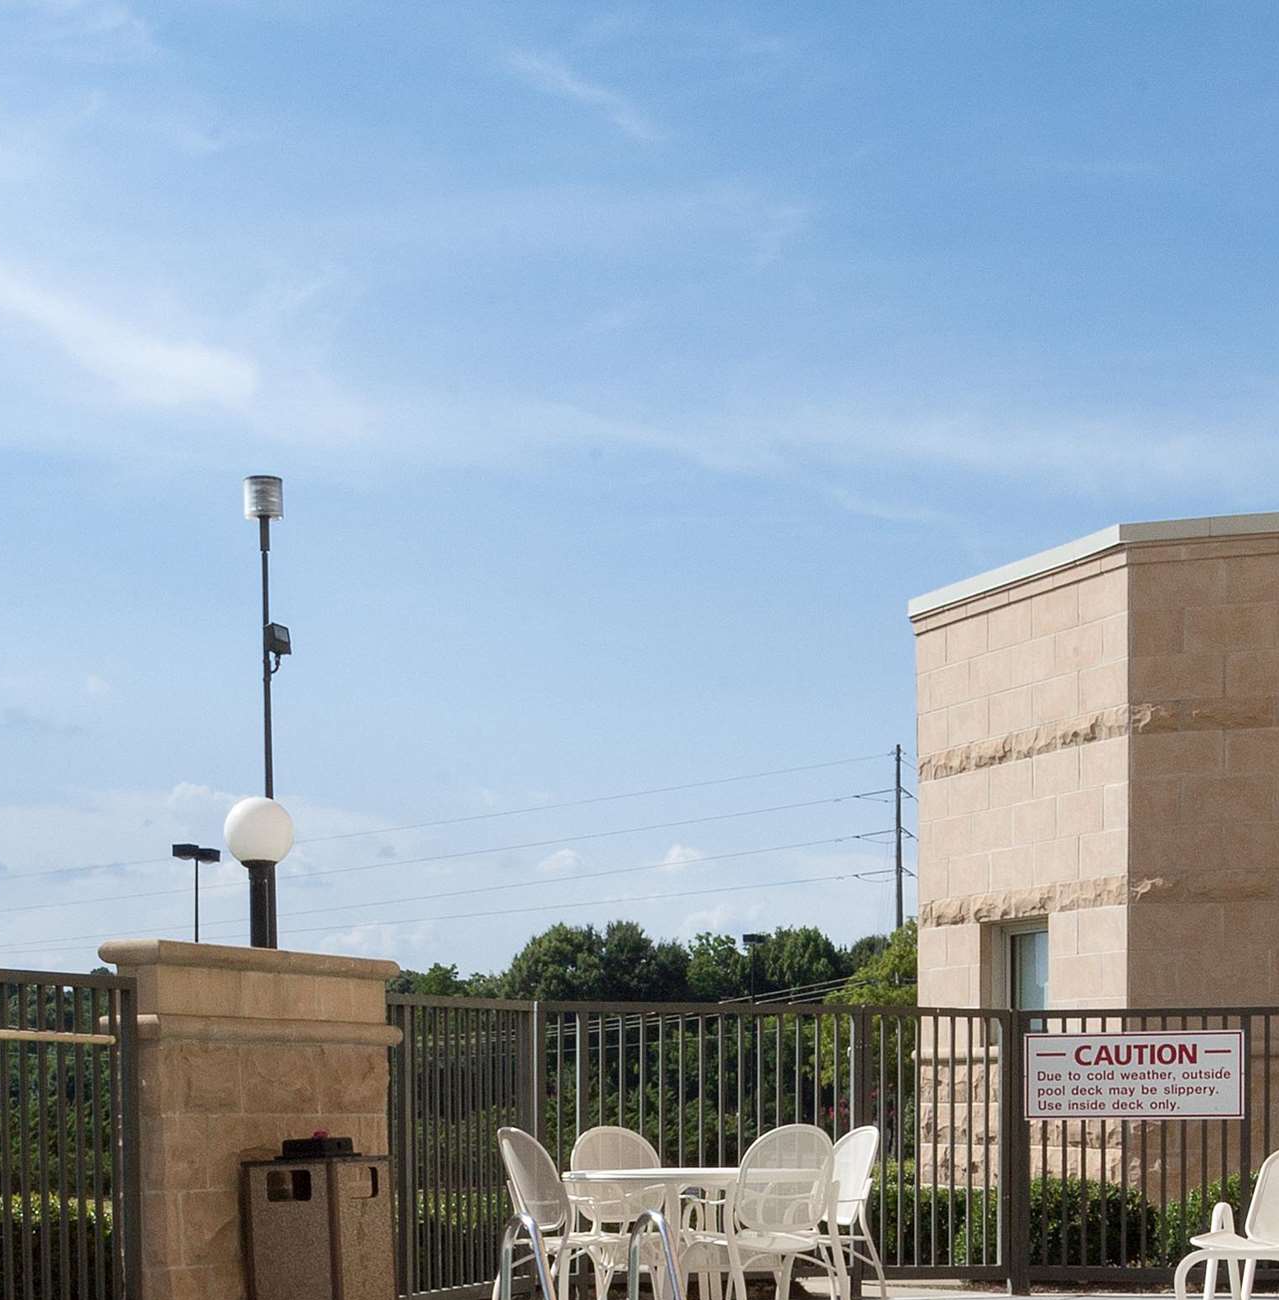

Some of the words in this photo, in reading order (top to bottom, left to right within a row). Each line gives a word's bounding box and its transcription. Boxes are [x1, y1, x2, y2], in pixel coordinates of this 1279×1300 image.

[1074, 1044, 1198, 1067] CAUTION
[1037, 1070, 1062, 1081] Due
[1068, 1070, 1081, 1081] to
[1086, 1070, 1115, 1081] cold
[1120, 1069, 1177, 1081] weather,
[1182, 1067, 1232, 1080] outside
[1037, 1085, 1066, 1098] pool
[1071, 1084, 1103, 1096] deck
[1108, 1086, 1135, 1097] may
[1141, 1084, 1158, 1095] be
[1163, 1083, 1219, 1097] slippery.
[1038, 1099, 1062, 1111] Use
[1068, 1099, 1106, 1111] inside
[1111, 1098, 1144, 1111] deck
[1149, 1098, 1180, 1112] only.
